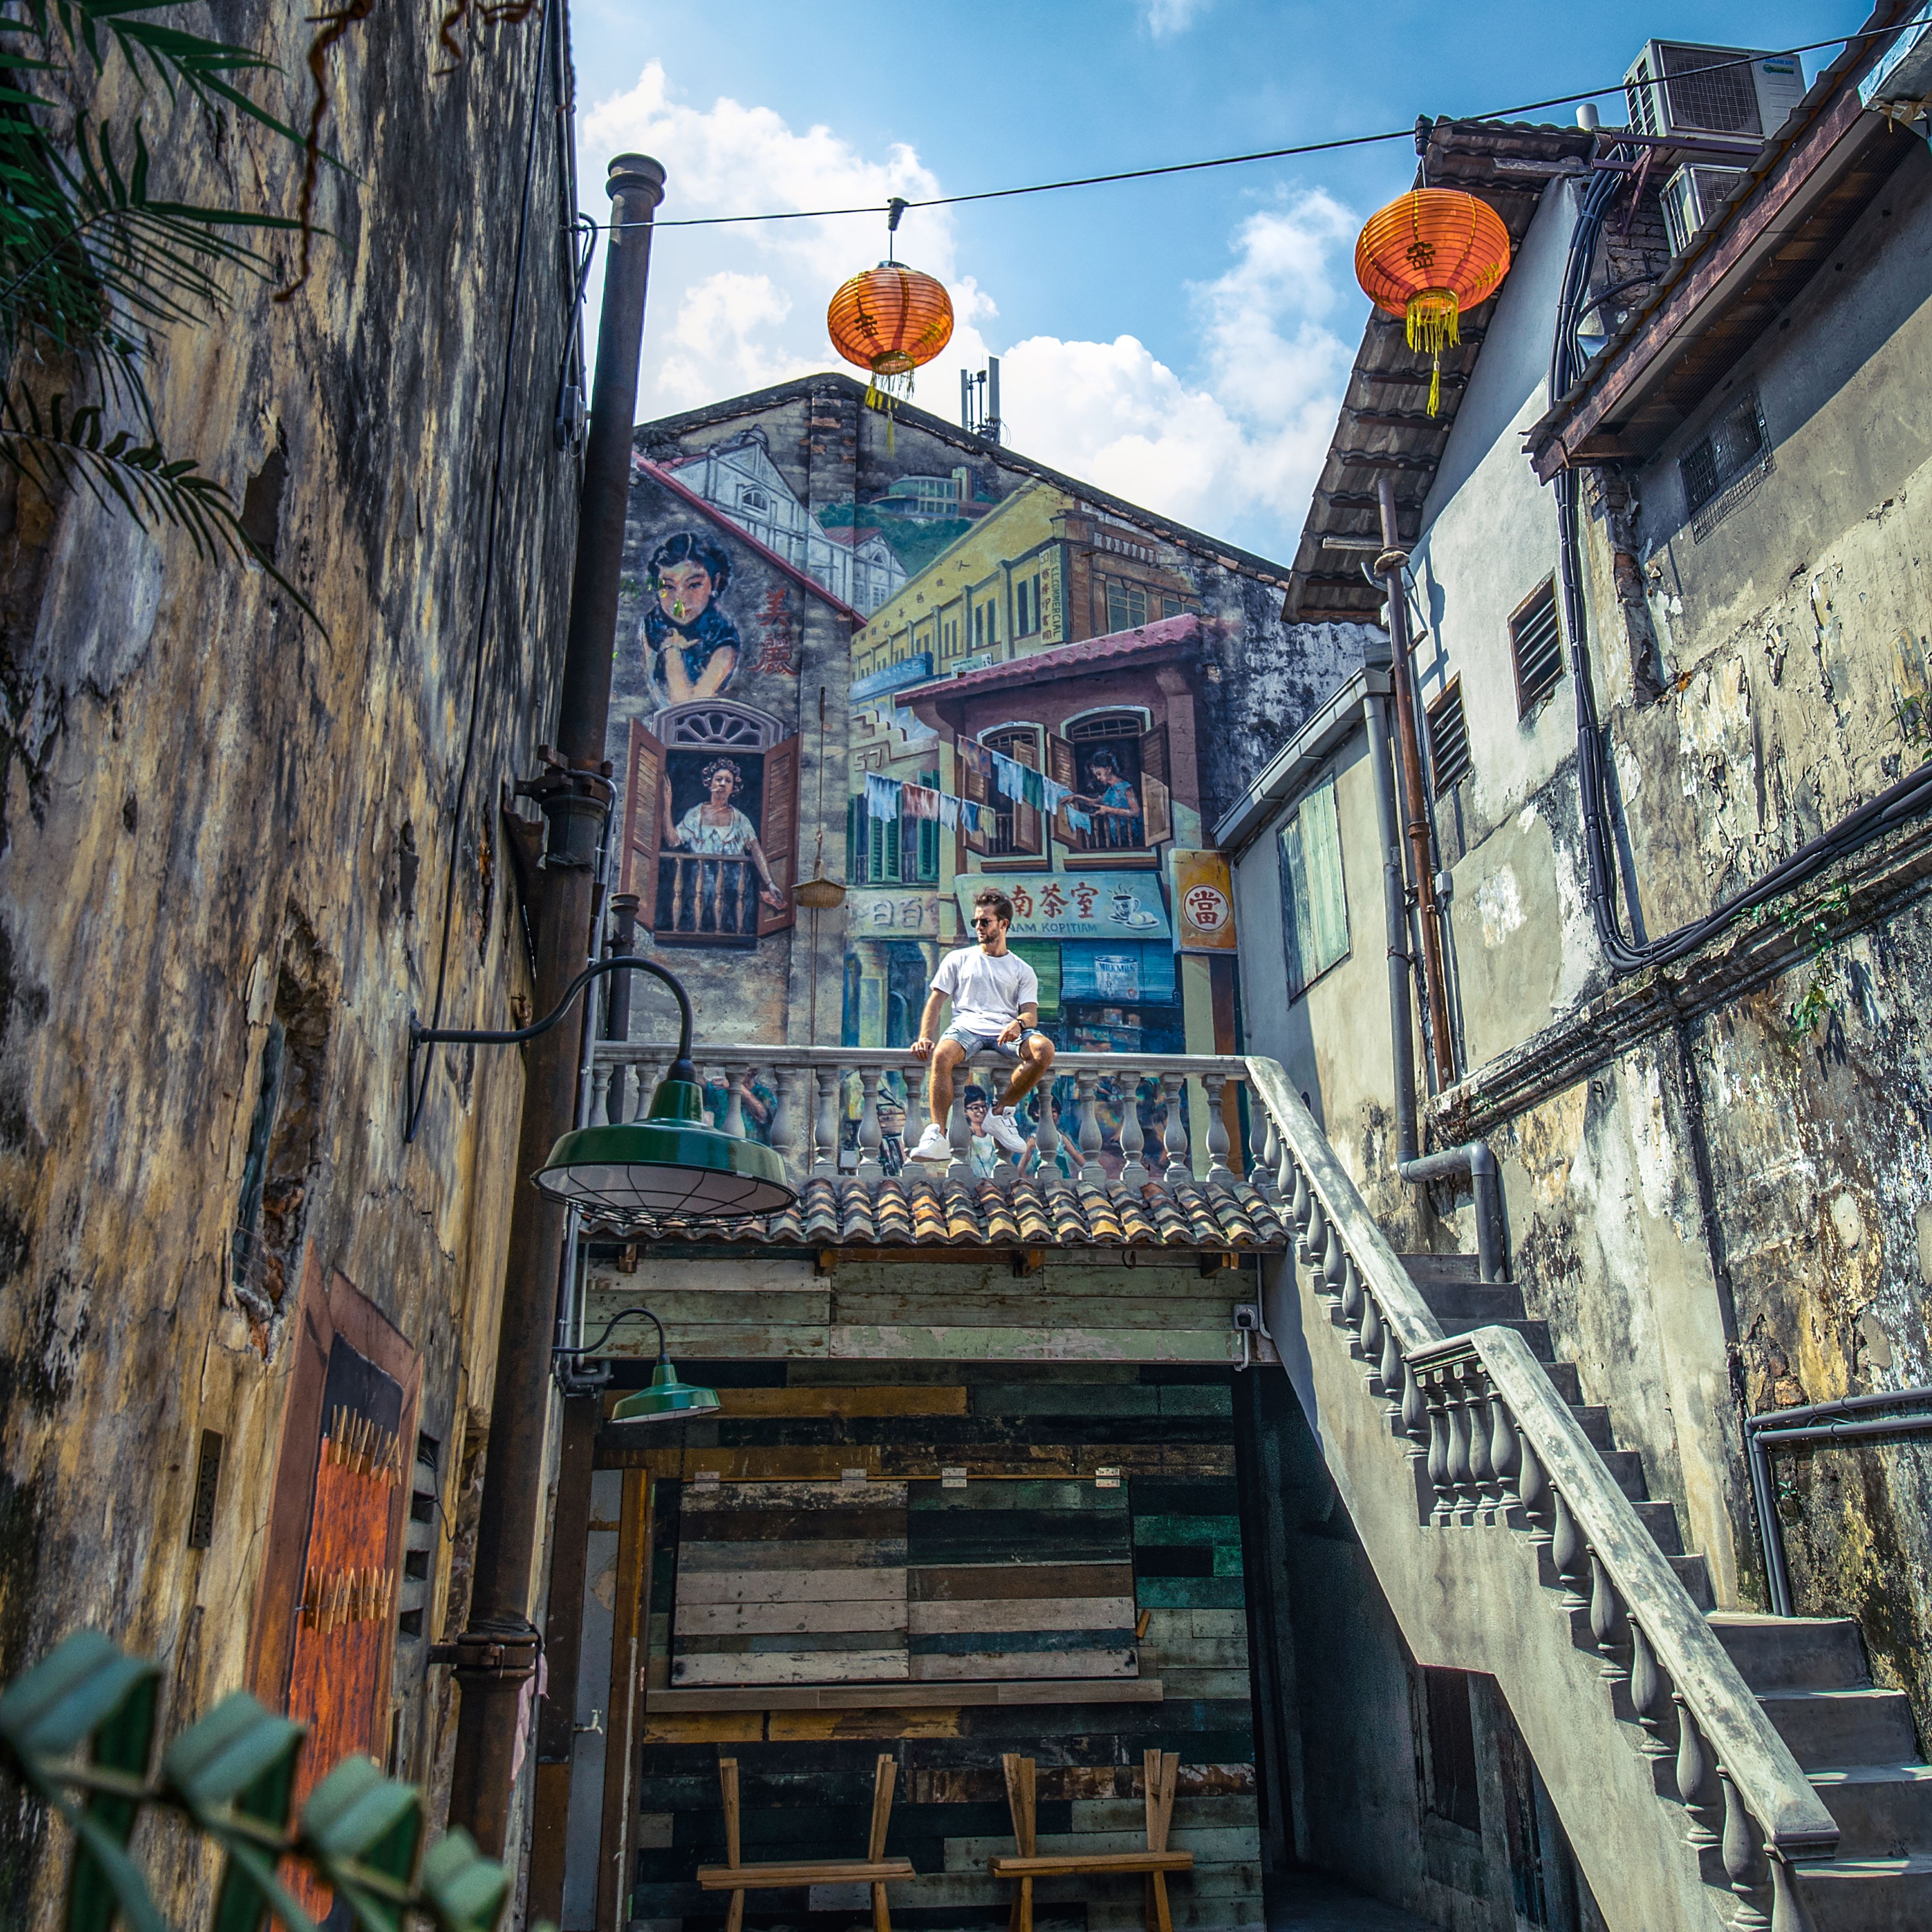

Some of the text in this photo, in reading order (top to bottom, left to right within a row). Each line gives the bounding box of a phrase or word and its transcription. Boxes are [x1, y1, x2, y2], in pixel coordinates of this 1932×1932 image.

[854, 748, 882, 772] 57
[989, 881, 1099, 918] 南茶室
[1189, 890, 1221, 925] 當
[1042, 923, 1097, 933] KOPITIAM
